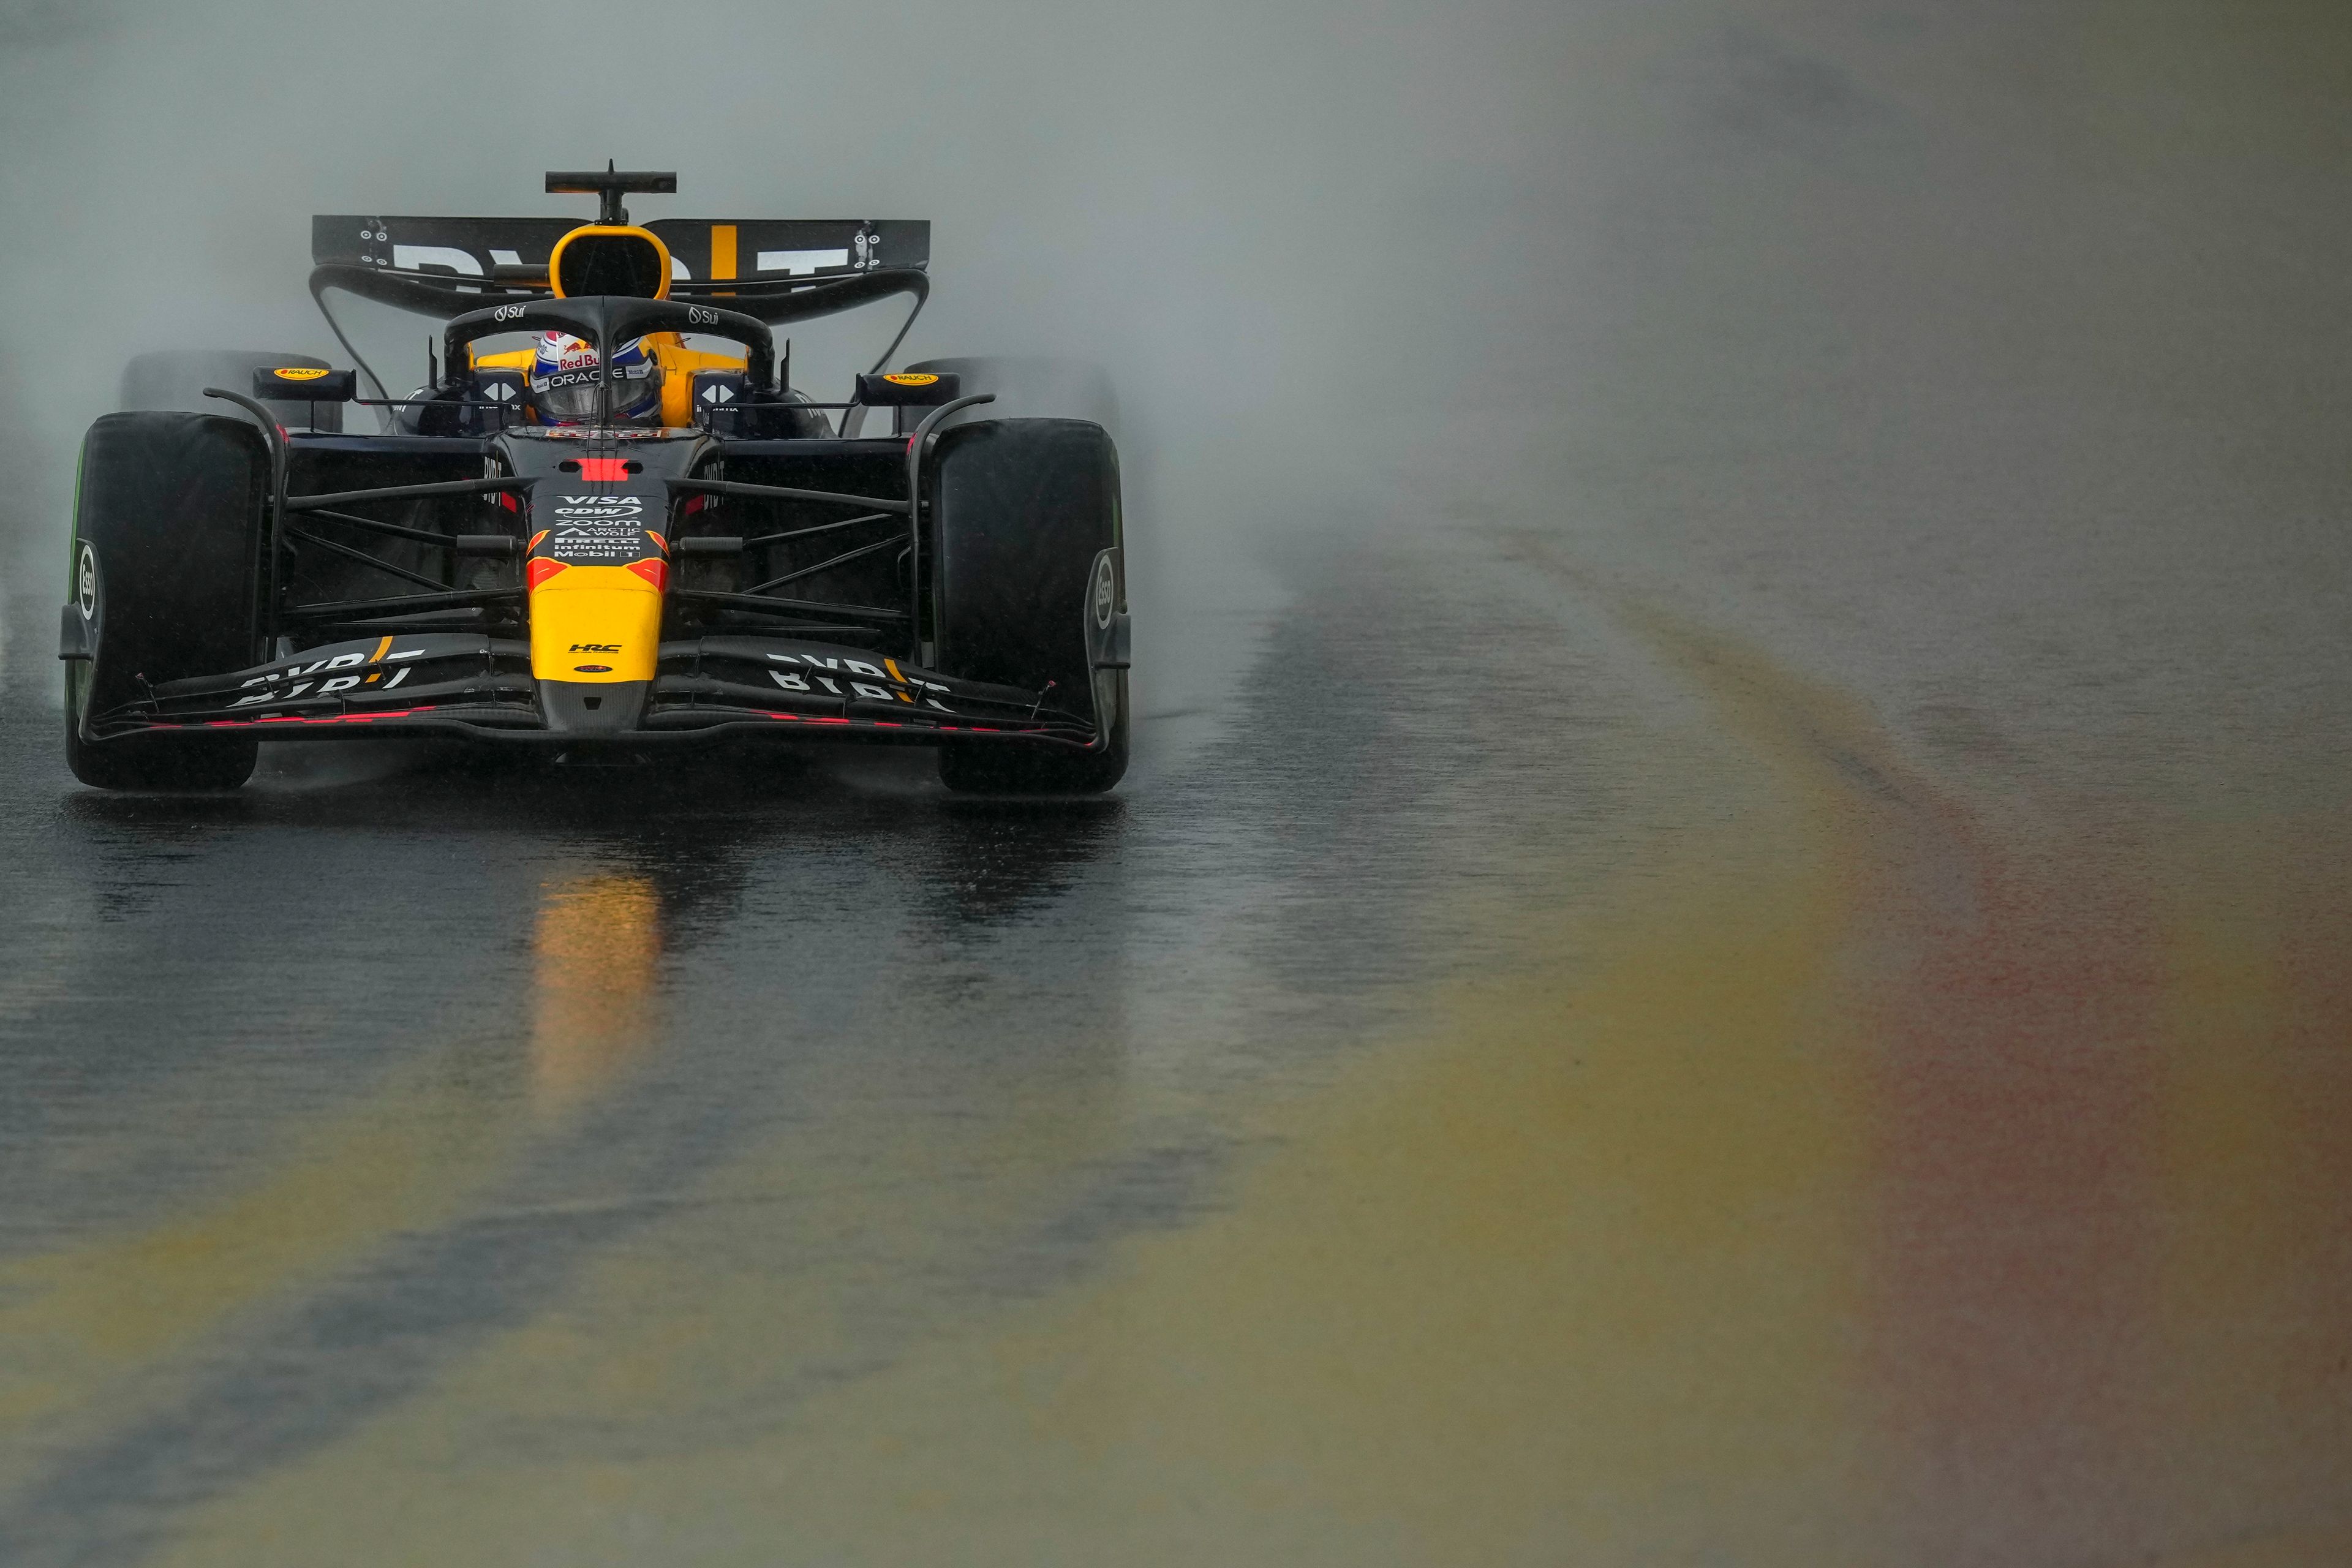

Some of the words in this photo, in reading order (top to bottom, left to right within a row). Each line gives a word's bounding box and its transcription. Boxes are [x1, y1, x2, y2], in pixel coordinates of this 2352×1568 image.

[507, 305, 526, 319] Sui
[702, 311, 719, 325] Sui
[560, 355, 582, 371] Red
[584, 354, 600, 366] Bu
[551, 368, 624, 387] ORACE
[556, 496, 642, 505] VISA
[82, 564, 93, 596] Esso
[1098, 576, 1110, 606] Esso
